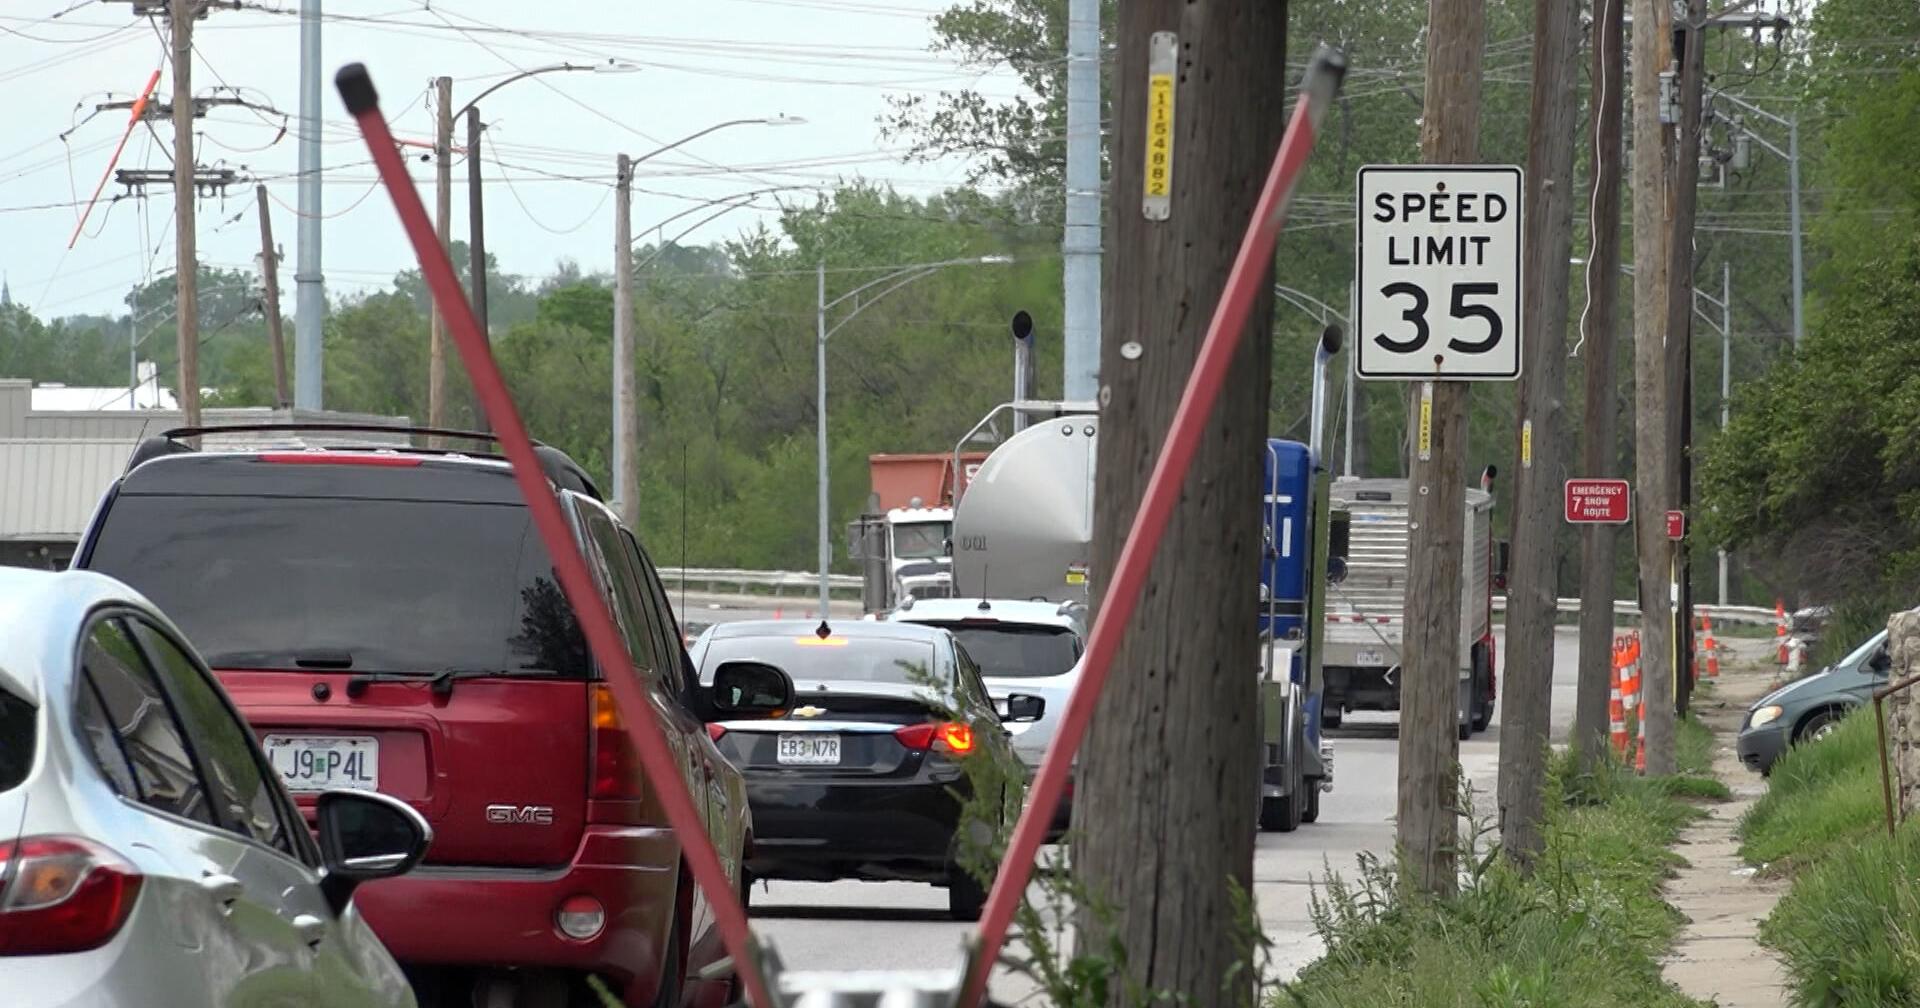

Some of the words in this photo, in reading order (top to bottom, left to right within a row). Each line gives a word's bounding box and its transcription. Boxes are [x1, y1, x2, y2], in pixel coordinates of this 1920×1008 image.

[1151, 92, 1167, 196] 1154882
[1373, 192, 1507, 223] SPEED
[1388, 236, 1491, 265] LIMIT
[1373, 281, 1504, 354] 35
[1572, 486, 1622, 495] EMERGENCY
[1584, 496, 1611, 505] SNOW
[1572, 496, 1582, 513] 7
[1583, 507, 1611, 517] ROUTE
[327, 750, 374, 781] P4L
[486, 804, 554, 825] GMC
